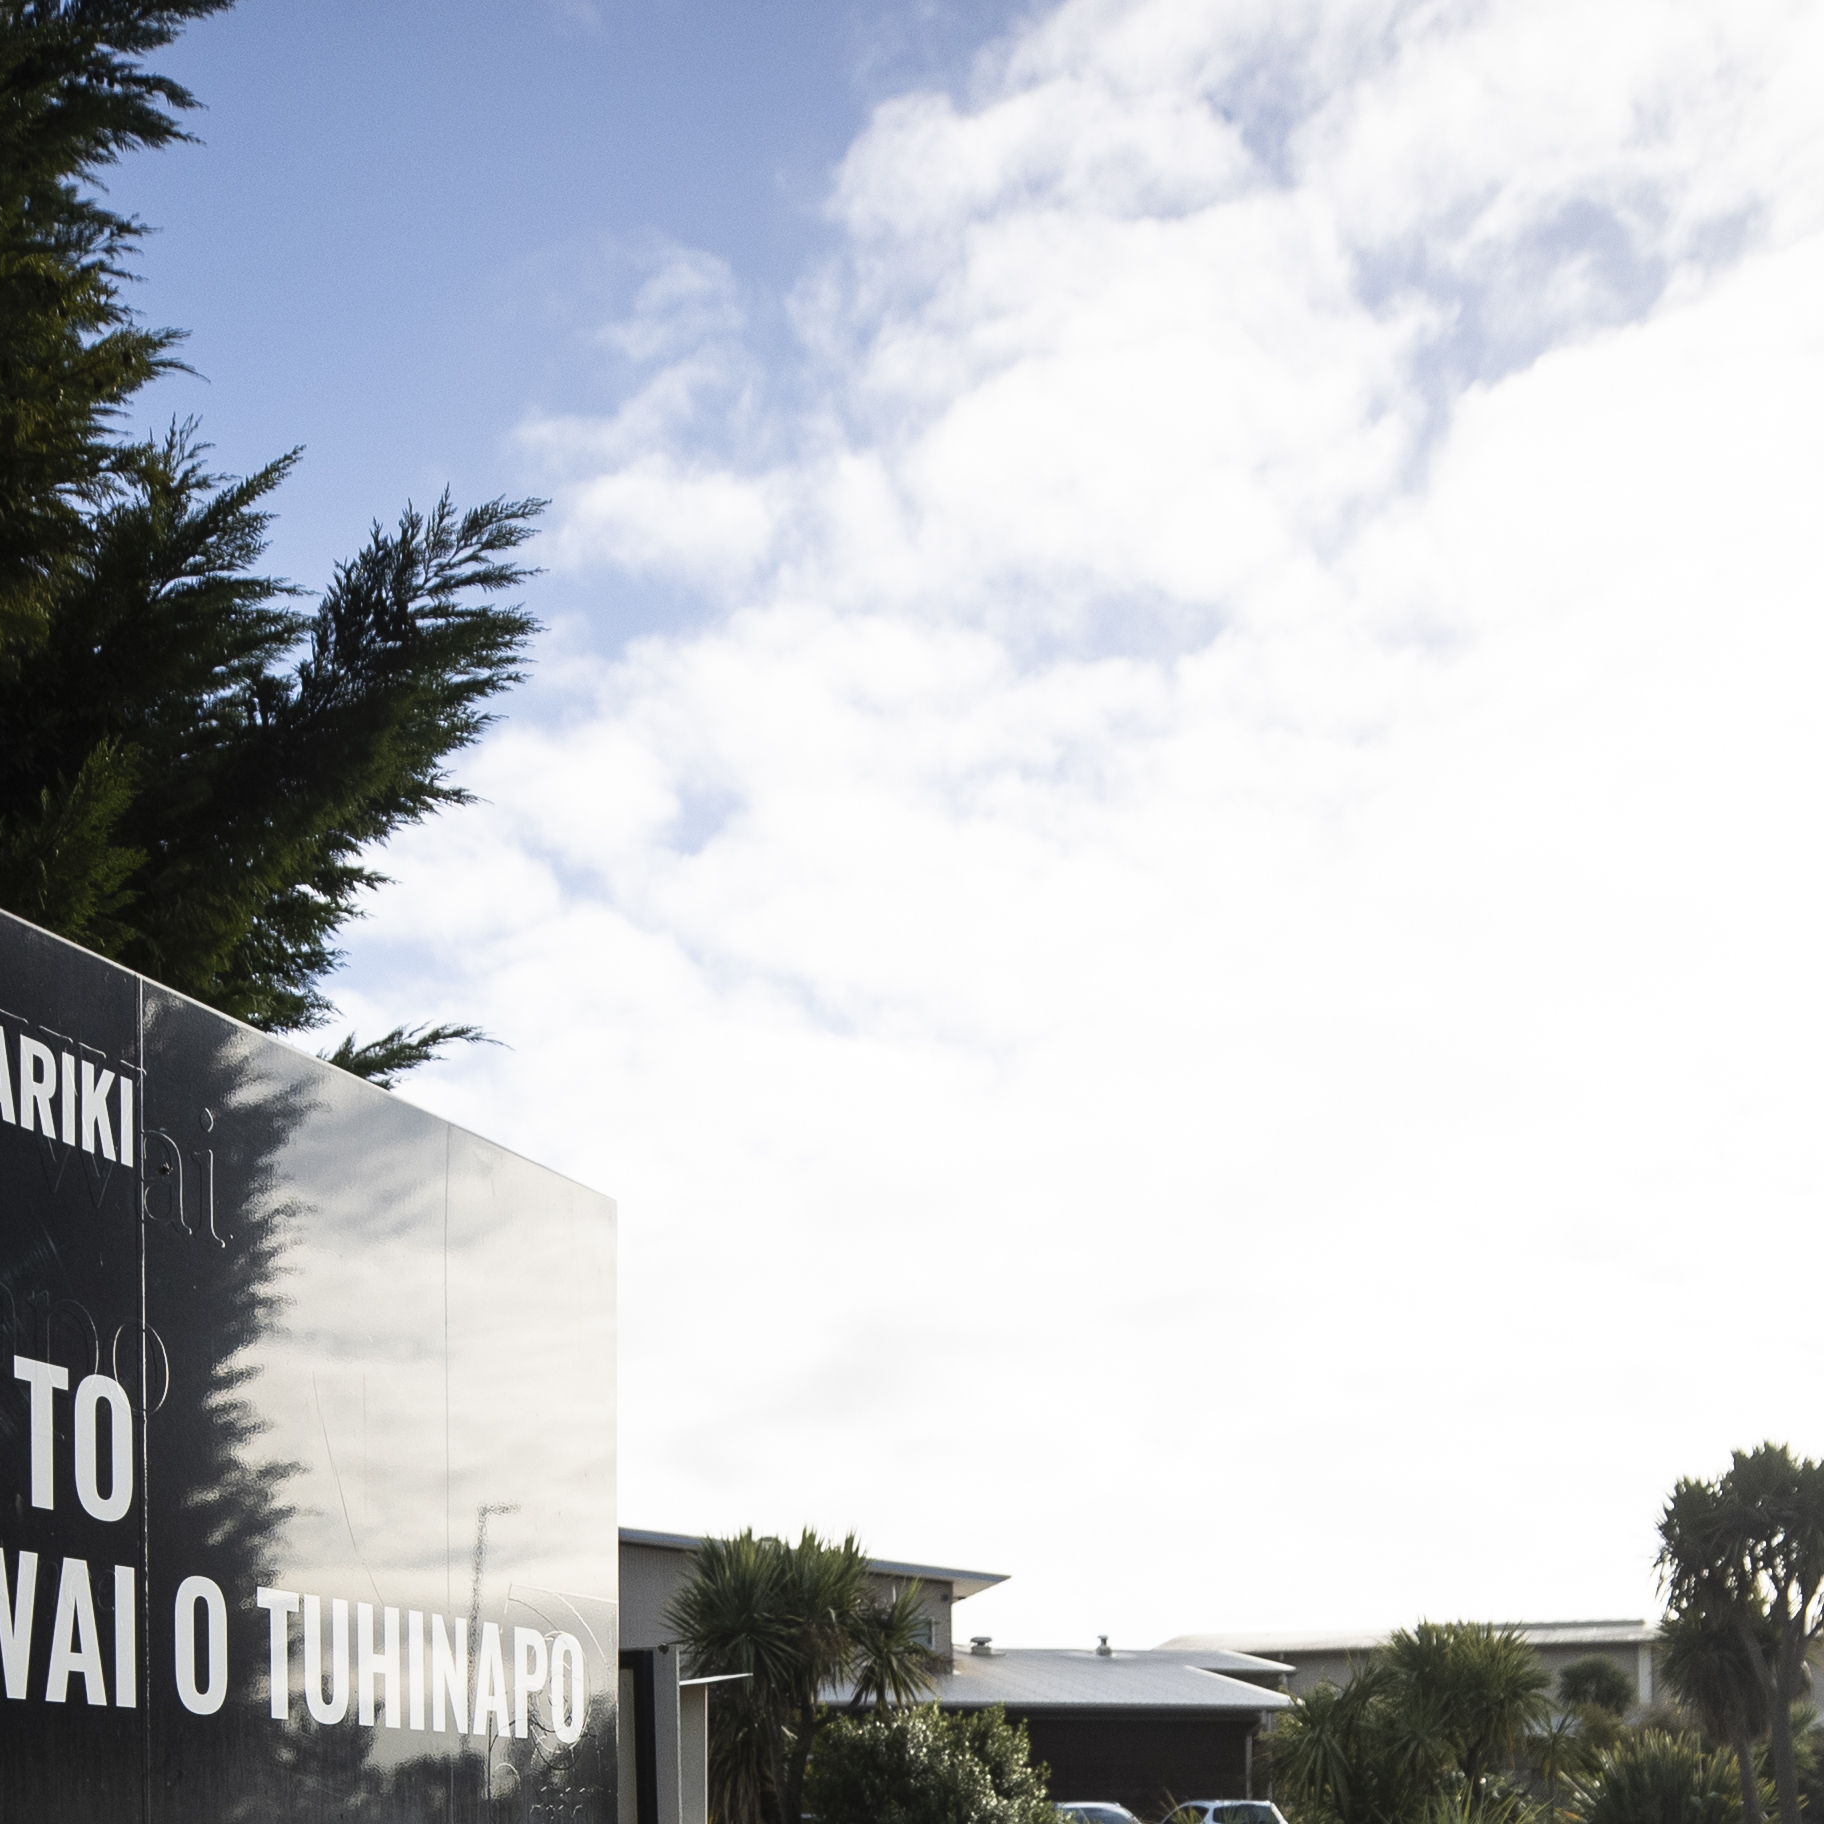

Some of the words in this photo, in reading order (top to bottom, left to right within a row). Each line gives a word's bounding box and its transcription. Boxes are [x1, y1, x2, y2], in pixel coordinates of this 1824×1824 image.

[12, 1354, 134, 1523] TO
[174, 1576, 229, 1716] O
[256, 1586, 585, 1745] TUHINAPO
